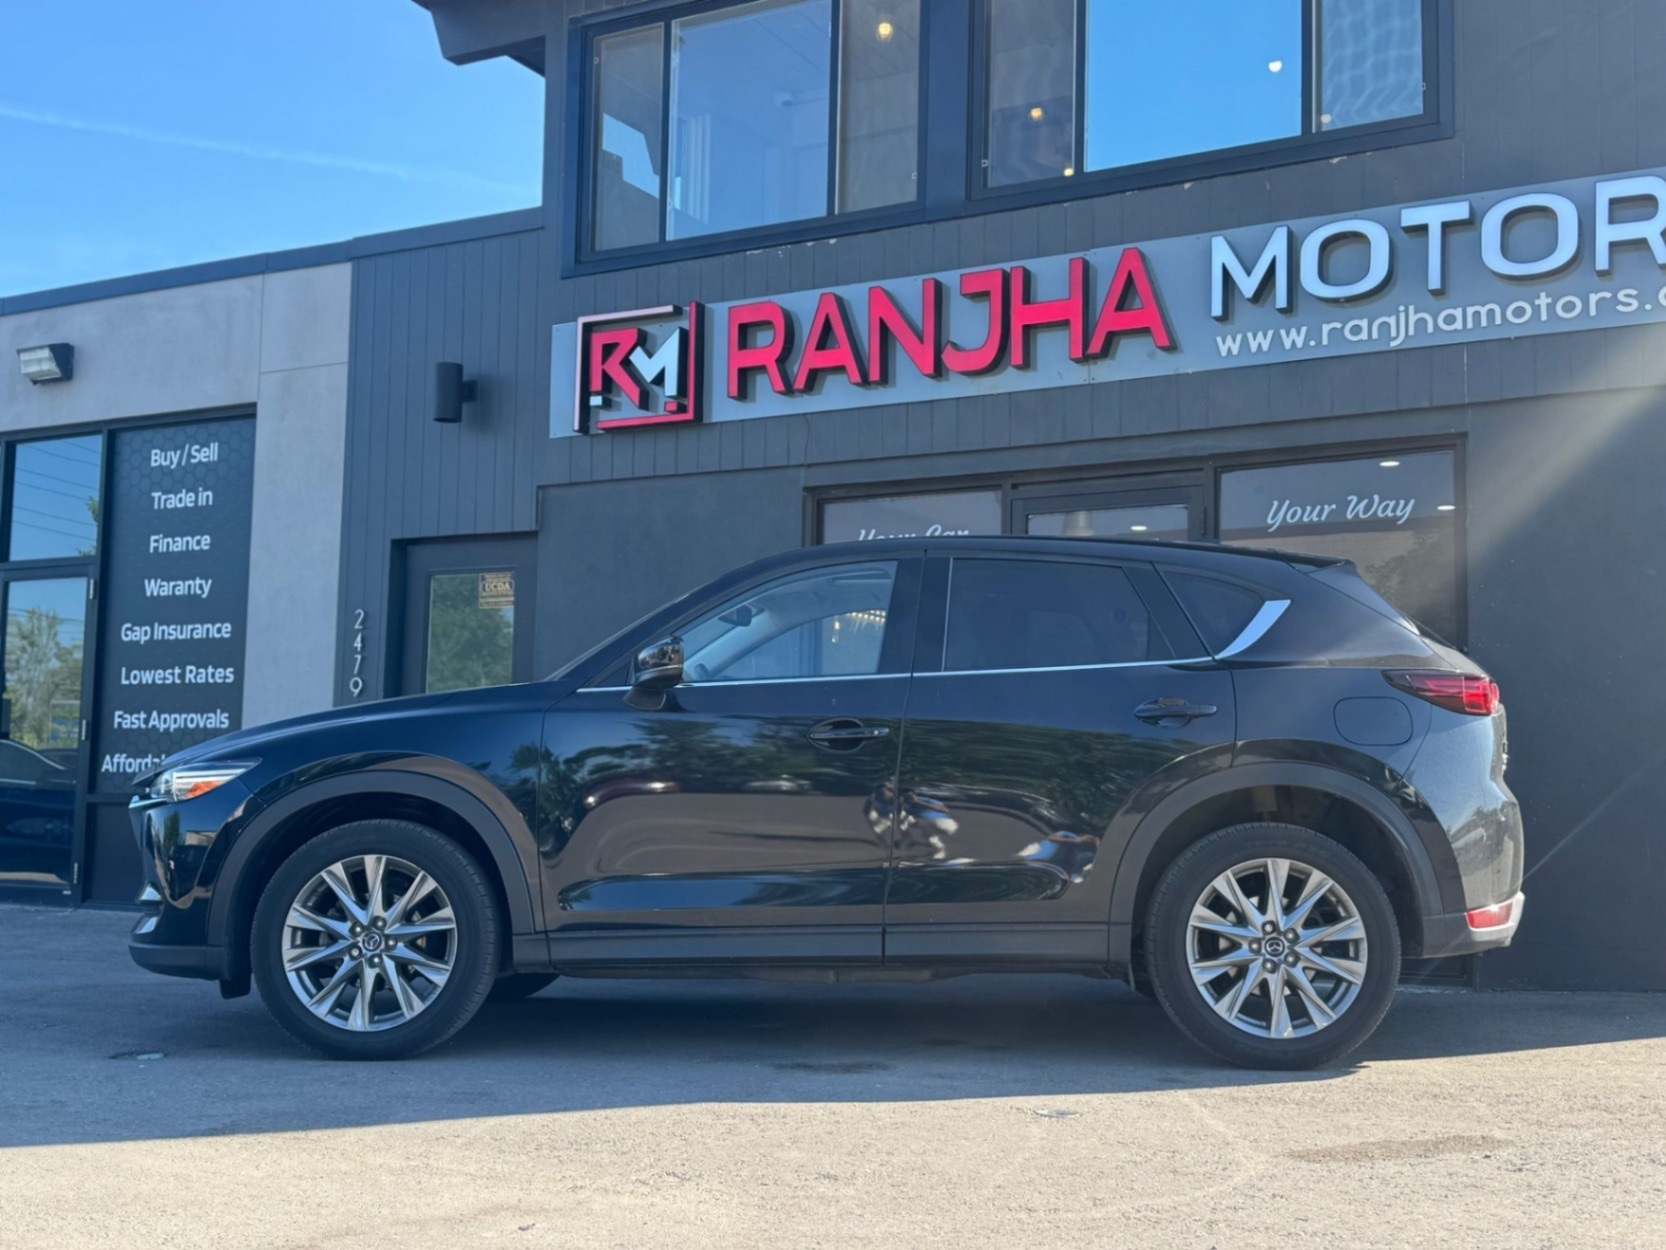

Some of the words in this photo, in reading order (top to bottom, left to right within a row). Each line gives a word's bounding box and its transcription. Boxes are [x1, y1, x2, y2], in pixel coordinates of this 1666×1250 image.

[727, 247, 1176, 400] RANJHA
[151, 489, 196, 510] Trade
[197, 487, 213, 506] in
[1266, 499, 1336, 532] Your
[1345, 494, 1415, 525] Way
[149, 534, 211, 553] Finance
[144, 576, 212, 598] Waranty
[121, 623, 151, 644] Gap
[153, 622, 232, 640] Insurance
[349, 608, 365, 697] 2479
[121, 666, 181, 684] Lowest
[185, 665, 235, 684] Rates
[113, 710, 147, 729] Fast
[147, 708, 229, 732] Approvals
[101, 753, 166, 773] Afford
